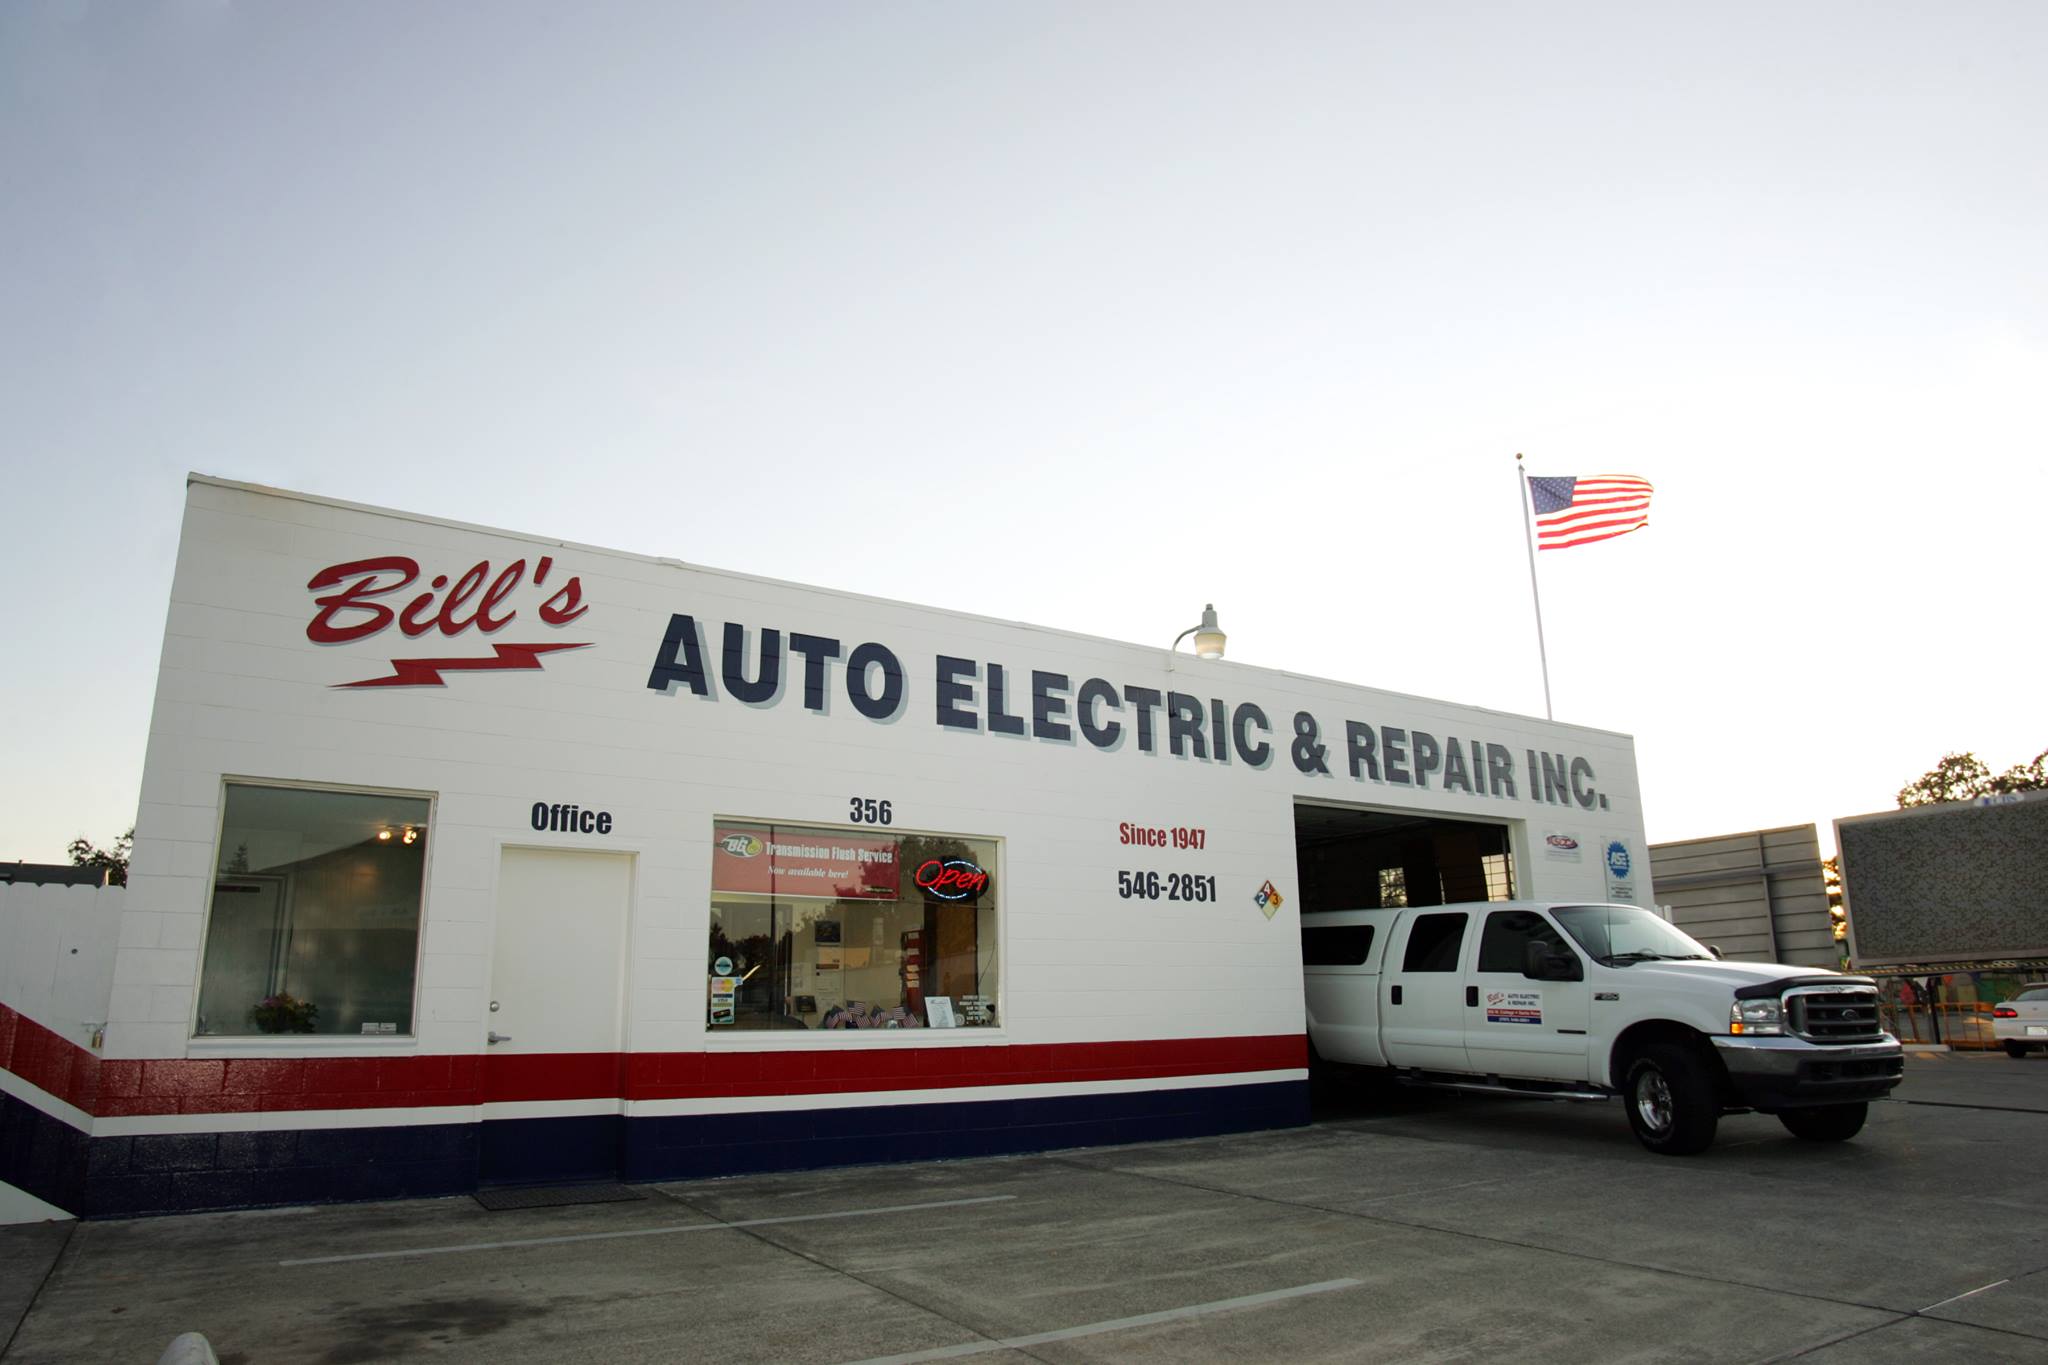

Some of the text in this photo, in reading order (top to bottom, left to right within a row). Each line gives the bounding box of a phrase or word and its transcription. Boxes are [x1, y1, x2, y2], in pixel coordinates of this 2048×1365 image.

[306, 556, 589, 644] Bill's
[647, 613, 1610, 809] AUTO ELECTRIC & REPAIR INC.
[531, 802, 612, 834] Office
[850, 797, 892, 825] 356
[1119, 822, 1206, 850] Since 1947
[766, 841, 893, 864] Transmission Flush Service
[768, 865, 849, 879] Now available here!
[916, 860, 987, 891] Open
[1118, 870, 1217, 902] 546-2851
[1258, 893, 1280, 906] 2 3
[1264, 883, 1272, 895] 4
